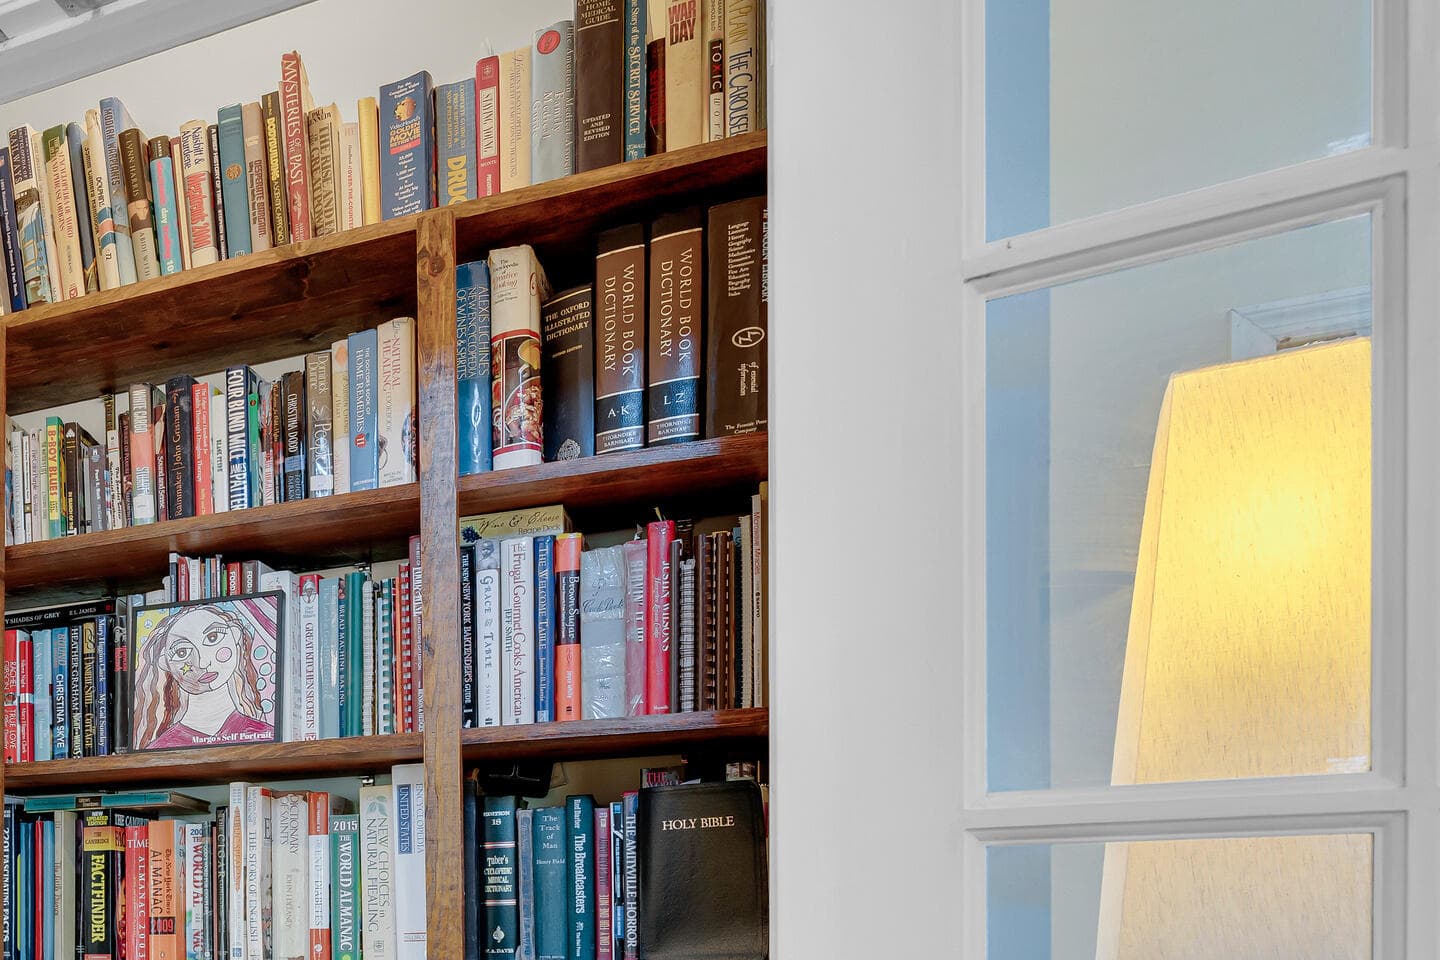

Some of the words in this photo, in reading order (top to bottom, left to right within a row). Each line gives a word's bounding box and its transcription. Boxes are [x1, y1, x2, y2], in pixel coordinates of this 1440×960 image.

[581, 6, 616, 20] MEDICAL
[585, 14, 611, 25] GUIDE
[631, 7, 639, 26] Story
[669, 0, 696, 19] WAR
[669, 19, 696, 46] DAY
[629, 47, 641, 88] SECRET
[712, 43, 722, 90] TOXIC
[283, 59, 300, 137] MYSTERIES
[553, 91, 563, 132] Family
[629, 91, 641, 135] SERVICE
[542, 91, 553, 139] Medical
[582, 113, 611, 124] UPDATED
[584, 125, 610, 135] REVISED
[390, 129, 420, 143] MOVIE
[584, 132, 610, 142] EDITION
[9, 131, 22, 184] RAILWAYS
[289, 155, 303, 185] PAST
[623, 264, 634, 323] WORLD
[680, 248, 692, 309] WORLD
[468, 287, 476, 310] NEW
[478, 287, 488, 323] ALEXIS
[545, 312, 558, 322] THE
[560, 301, 589, 316] OXFORD
[660, 261, 672, 357] DICTIONARY
[545, 311, 590, 332] ILLUSTRATED
[546, 321, 589, 341] DICTIONARY
[605, 276, 615, 371] DICTIONARY
[467, 313, 477, 378] ENCYCLOPEDIA
[623, 330, 634, 375] BOOK
[679, 316, 692, 361] BOOK
[317, 355, 328, 393] Dominick
[392, 338, 400, 390] NATURAL
[133, 390, 146, 410] WHITE
[227, 370, 244, 399] FOUR
[134, 412, 147, 432] CARGO
[228, 402, 246, 432] BLIND
[288, 394, 297, 430] CHRISTINA
[608, 406, 629, 418] A-K
[48, 430, 57, 463] B-BOY
[229, 435, 245, 458] MICE
[288, 432, 297, 452] DODD
[49, 466, 58, 496] BLUES
[509, 553, 525, 583] Frugal
[539, 547, 547, 566] THE
[481, 576, 493, 613] GRACE
[513, 586, 526, 630] Gourmet
[539, 569, 548, 616] WELCOME
[569, 576, 578, 608] Brown
[10, 616, 33, 624] SHADES
[504, 609, 512, 625] JEFF
[566, 609, 578, 639] Sugar
[306, 623, 314, 651] GREAT
[514, 633, 526, 665] Cooks
[539, 619, 549, 649] TABLE
[484, 633, 494, 668] TABLE
[306, 652, 314, 689] KITCHEN
[514, 668, 526, 716] American
[306, 690, 314, 728] SECRETS
[222, 733, 238, 741] Self
[240, 731, 272, 740] Portrait
[400, 787, 409, 819] UNITED
[334, 821, 357, 831] 2015
[378, 818, 388, 846] NEW
[401, 821, 409, 852] STATES
[627, 814, 635, 835] THE
[662, 818, 696, 830] HOLY
[701, 816, 734, 828] BIBLE
[367, 819, 378, 874] NATURAL
[340, 842, 351, 886] WORLD
[379, 851, 389, 906] CHOICES
[627, 839, 636, 897] AMITYVILLE
[91, 855, 105, 942] FACTFINDER
[368, 877, 379, 932] HEALING
[341, 890, 352, 951] ALMANAC
[628, 902, 637, 947] HORROR
